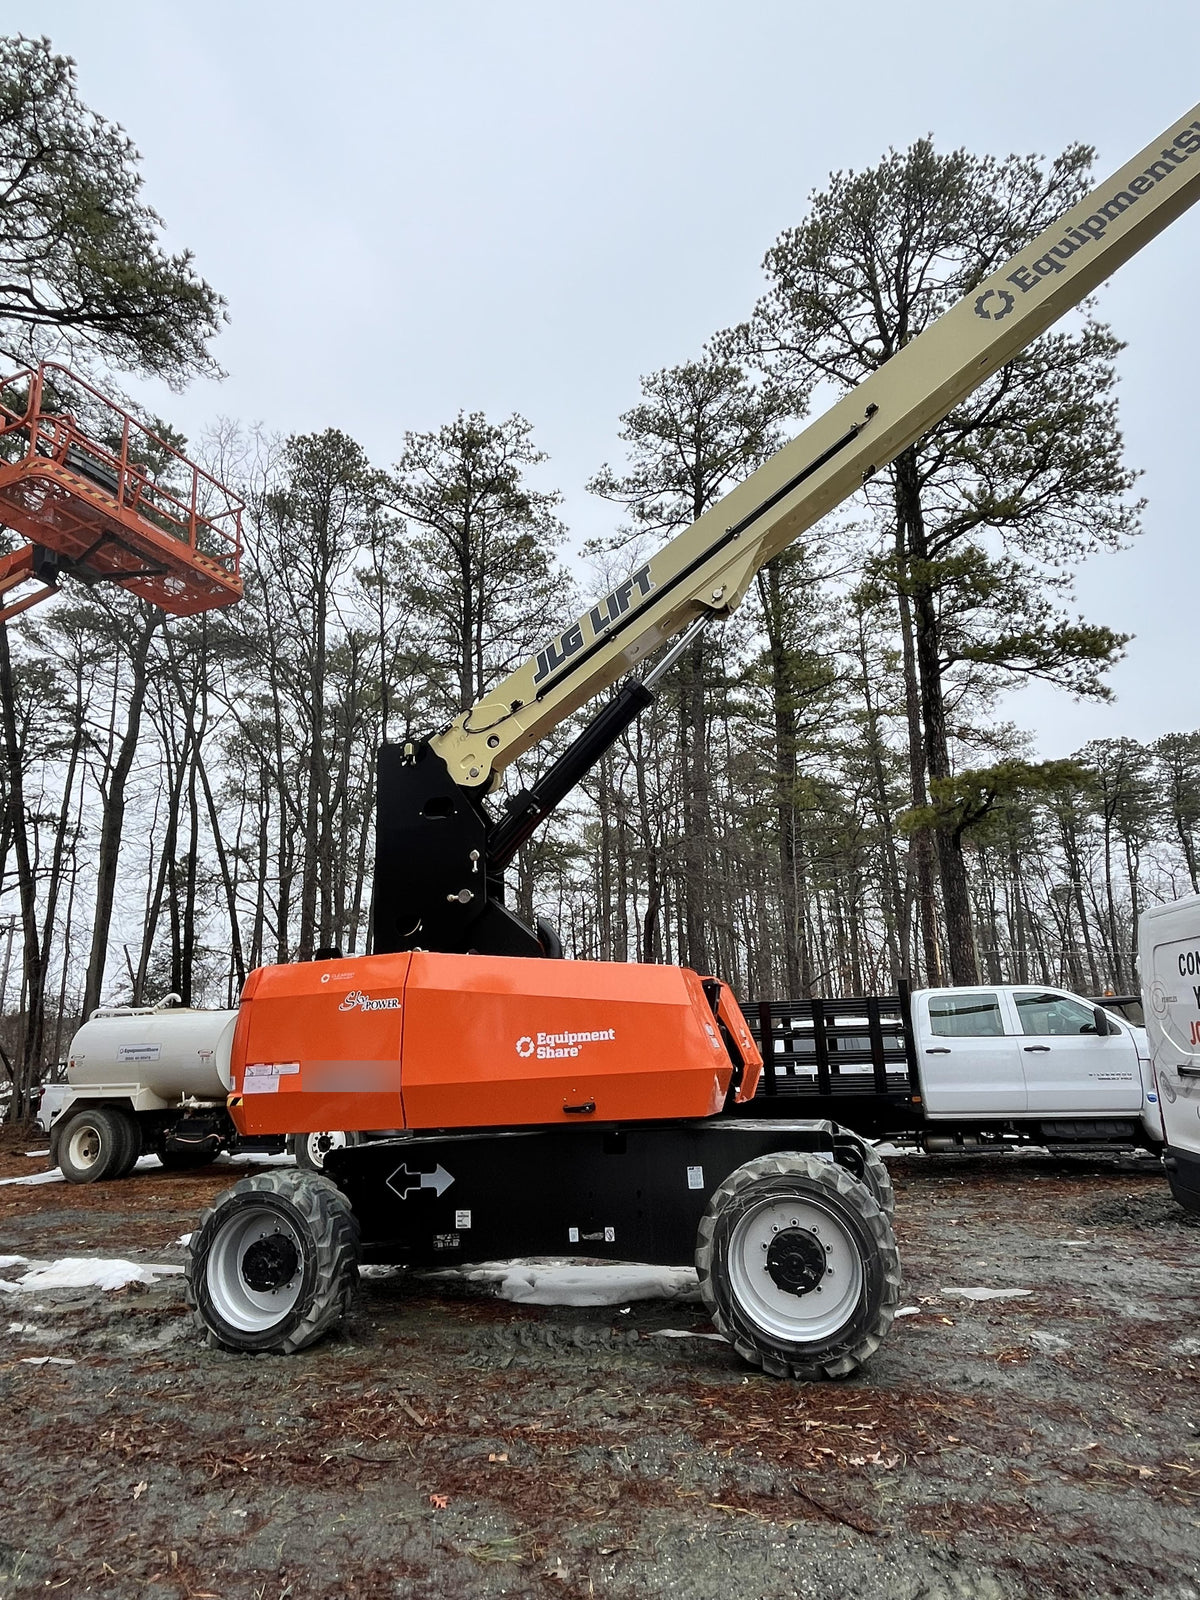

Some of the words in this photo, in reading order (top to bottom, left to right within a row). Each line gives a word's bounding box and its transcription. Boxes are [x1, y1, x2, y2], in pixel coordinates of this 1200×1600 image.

[1006, 121, 1200, 293] EquipmentS
[534, 622, 584, 685] JLG
[589, 563, 652, 636] LIFT
[365, 998, 400, 1010] POWER
[536, 1028, 615, 1046] Equipment
[536, 1045, 579, 1059] Share
